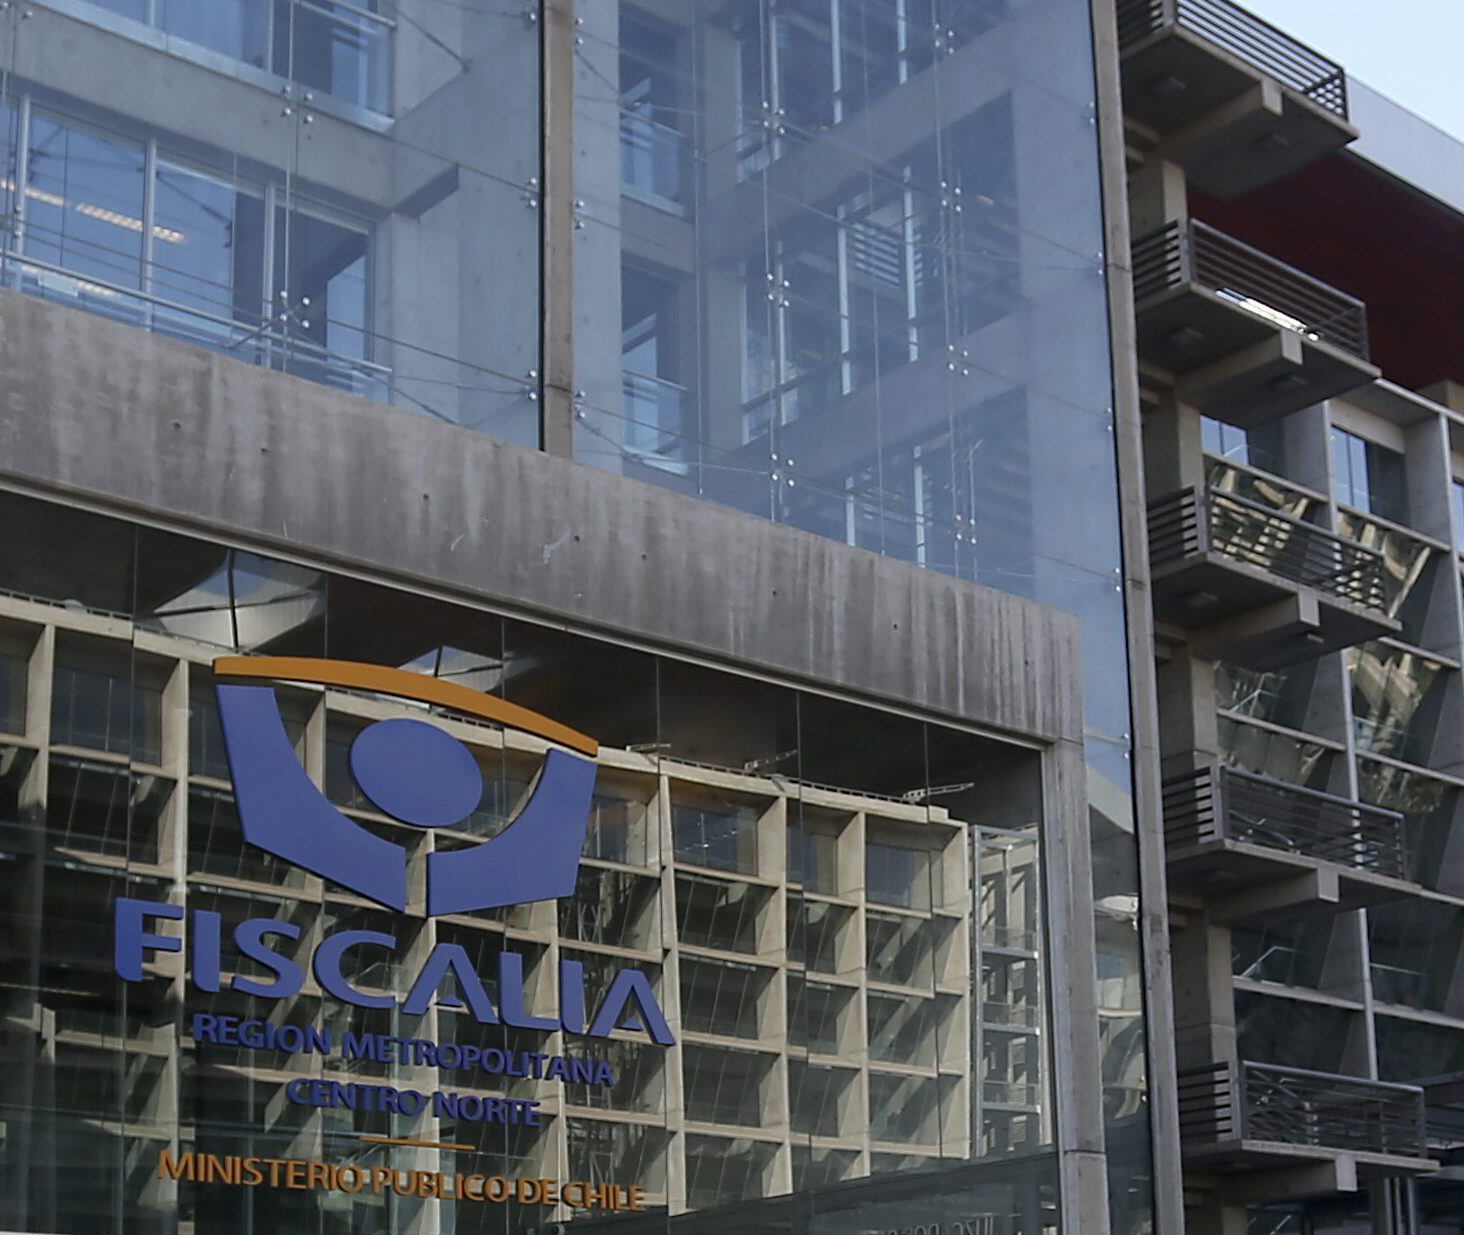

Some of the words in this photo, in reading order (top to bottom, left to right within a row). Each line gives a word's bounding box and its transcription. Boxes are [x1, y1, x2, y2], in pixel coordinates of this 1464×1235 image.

[114, 897, 676, 1046] FISCALIA
[193, 1013, 334, 1055] REGION
[342, 1031, 615, 1087] METROPOLITANA
[287, 1078, 425, 1117] CENTRO
[434, 1091, 542, 1128] NORTE
[157, 1150, 364, 1194] MINISTERIO
[373, 1167, 508, 1203] PUBLICO
[516, 1178, 559, 1206] DE
[562, 1181, 646, 1213] CHILE
